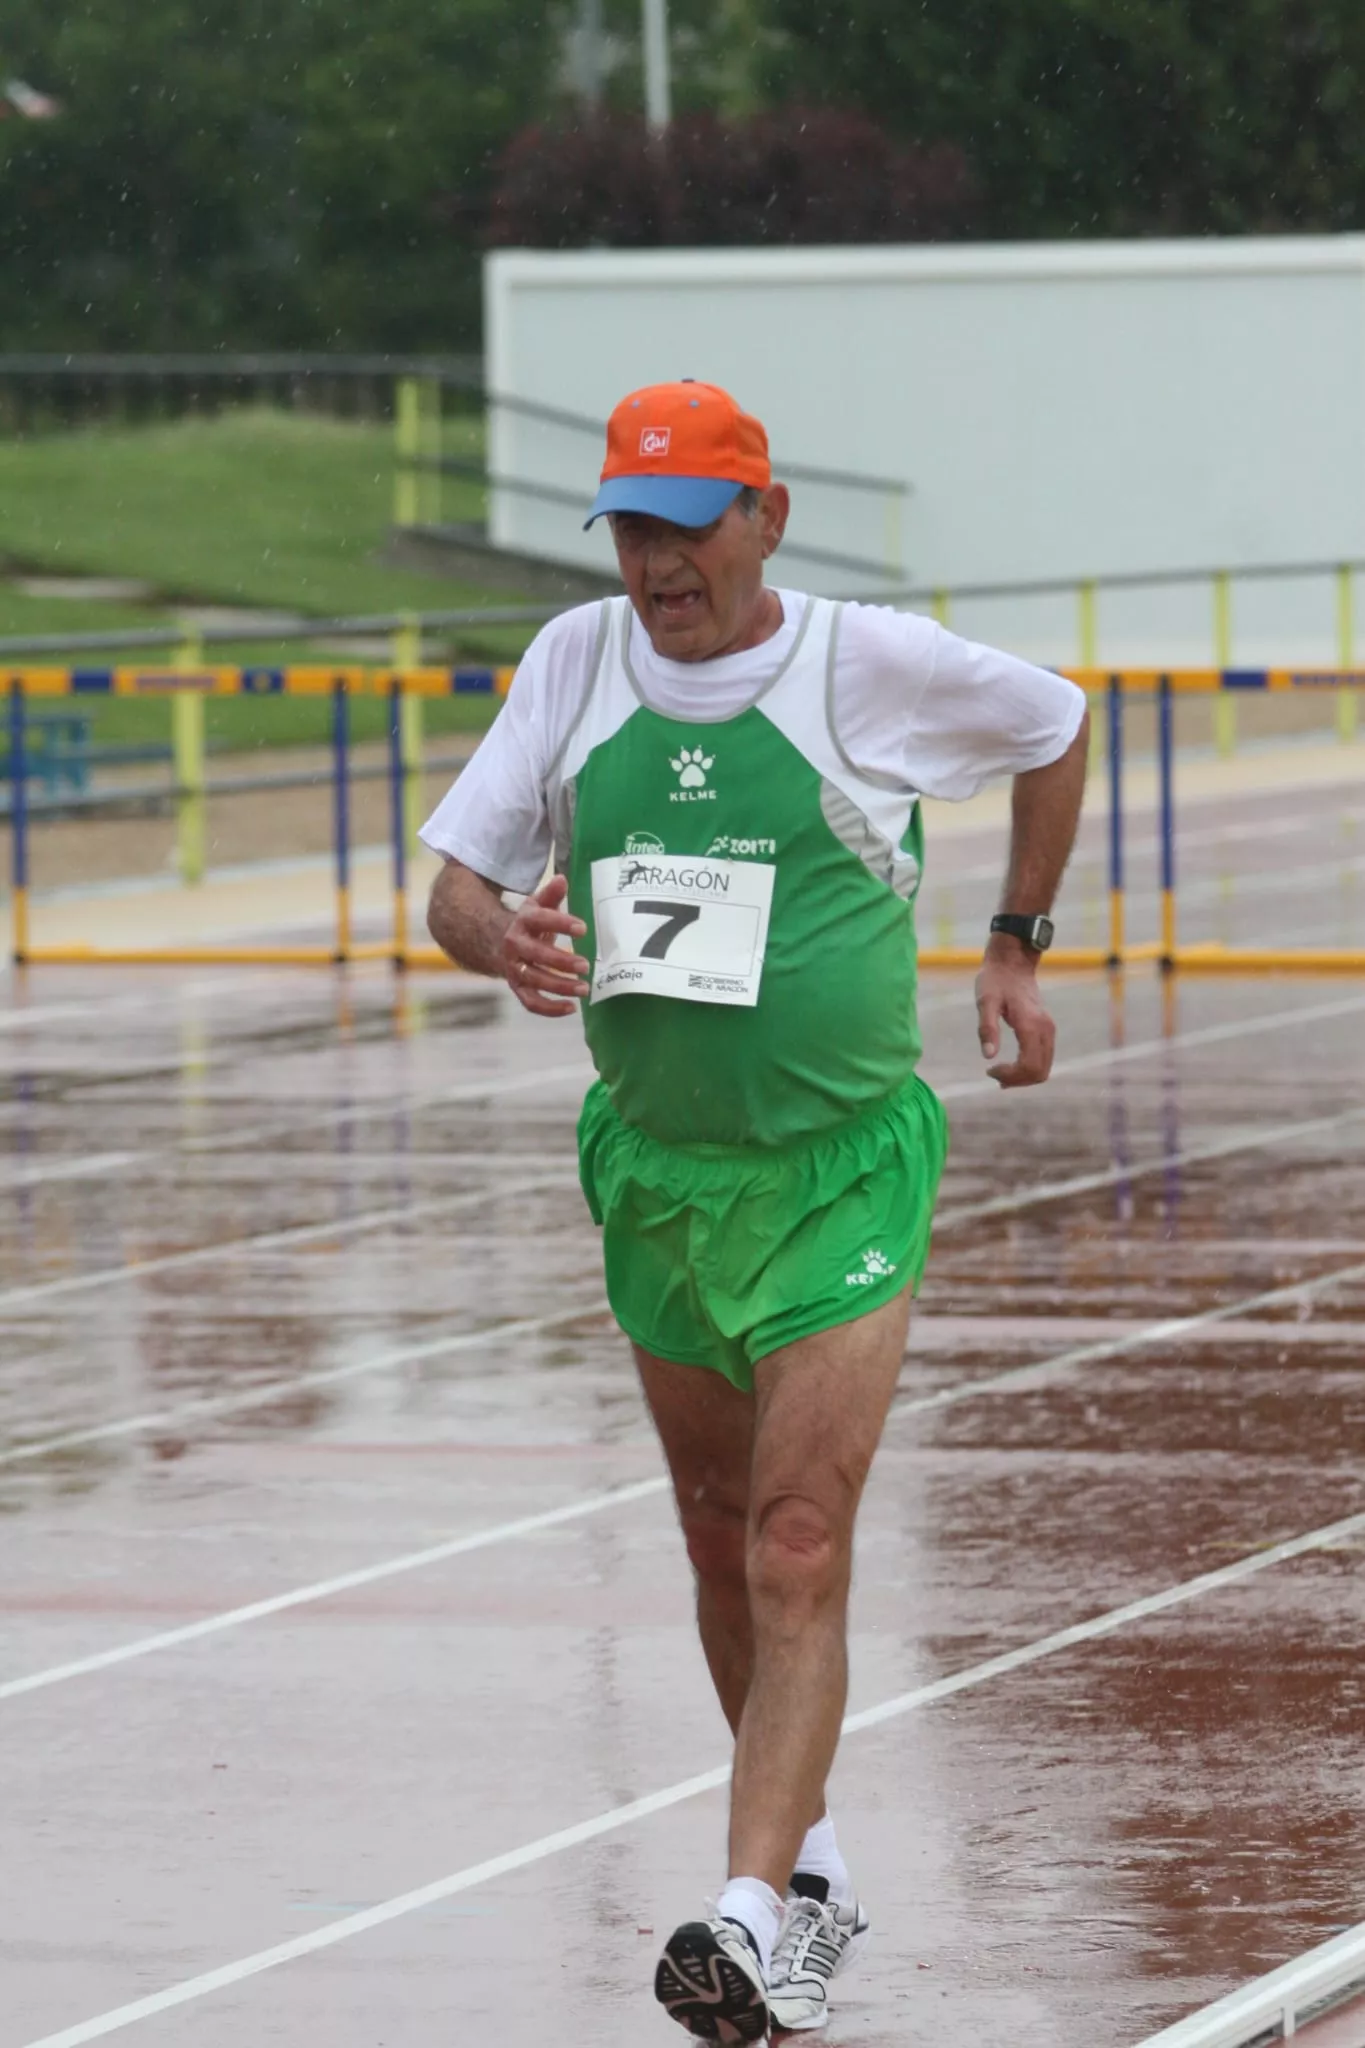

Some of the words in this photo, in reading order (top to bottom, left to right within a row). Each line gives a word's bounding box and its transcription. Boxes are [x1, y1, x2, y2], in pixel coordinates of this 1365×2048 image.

[669, 790, 717, 802] KELME
[729, 838, 776, 856] ZOITI
[634, 865, 730, 891] ARAGÓN
[632, 900, 701, 960] 7
